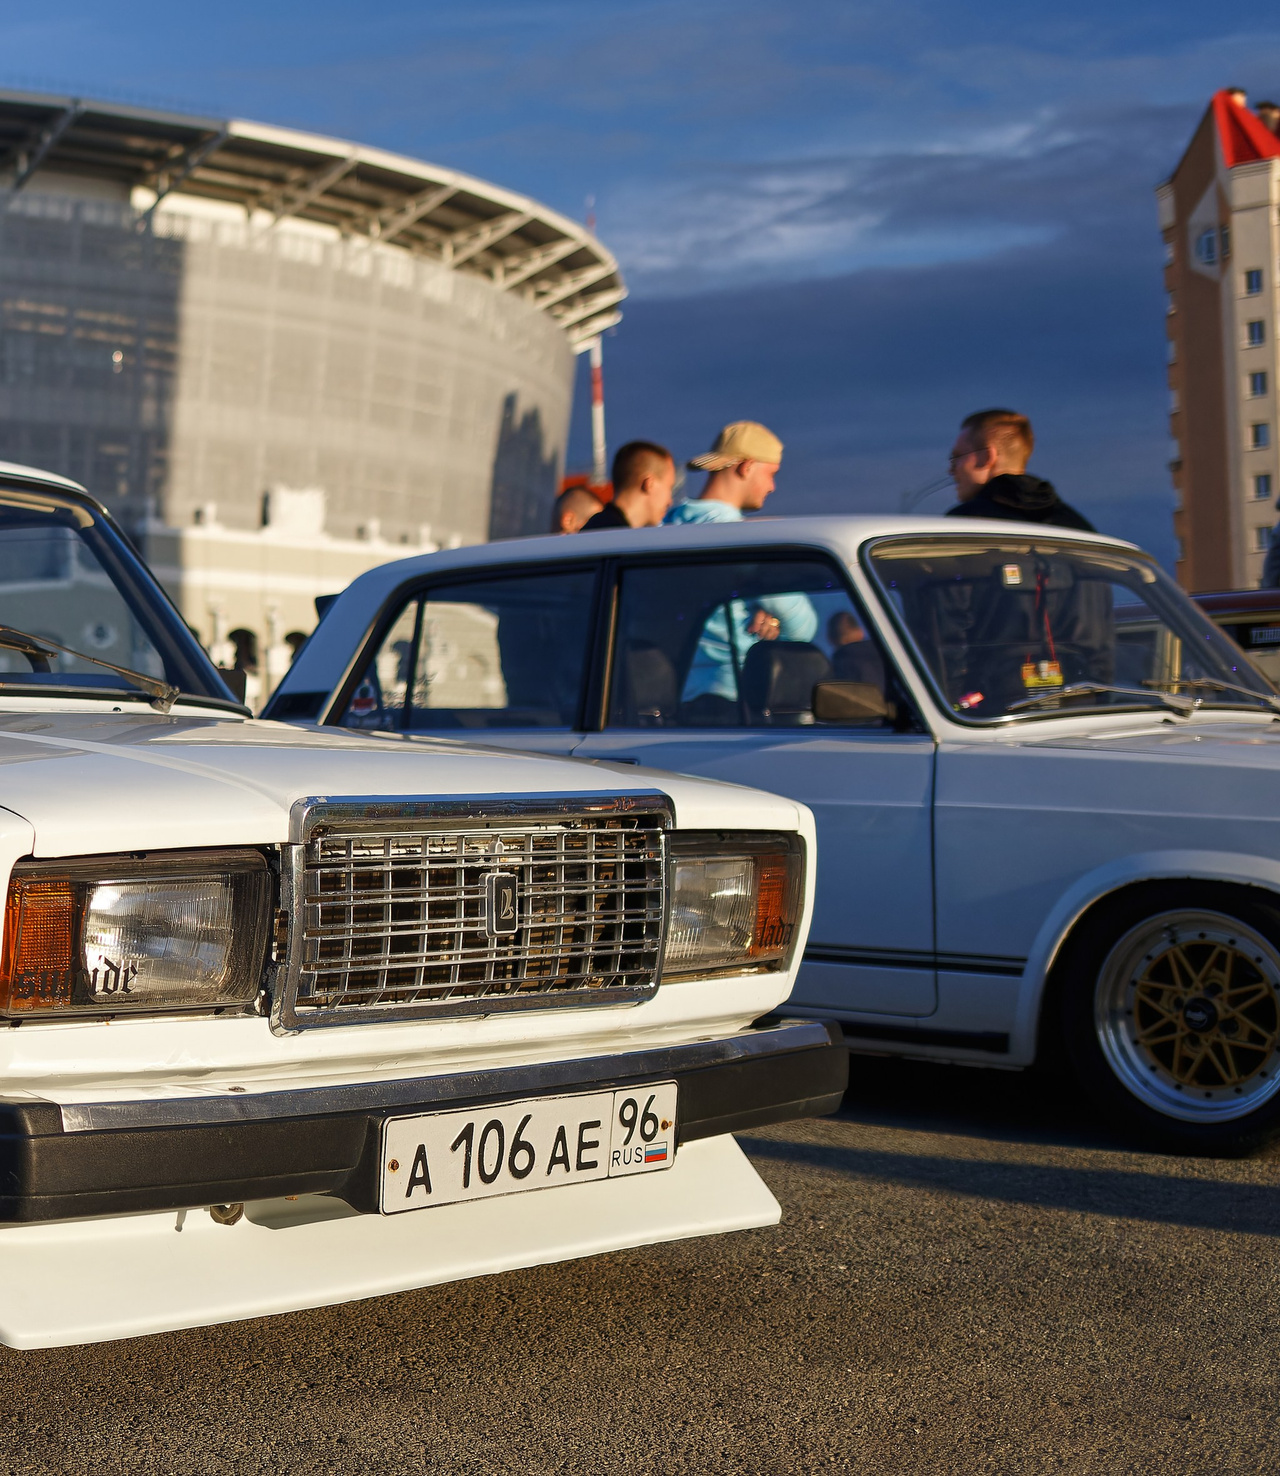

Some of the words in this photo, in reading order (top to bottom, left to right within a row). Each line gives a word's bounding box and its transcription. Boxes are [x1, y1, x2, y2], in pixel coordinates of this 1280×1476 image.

[451, 1114, 536, 1189] 106
[618, 1094, 659, 1146] 96
[612, 1146, 643, 1167] RUS
